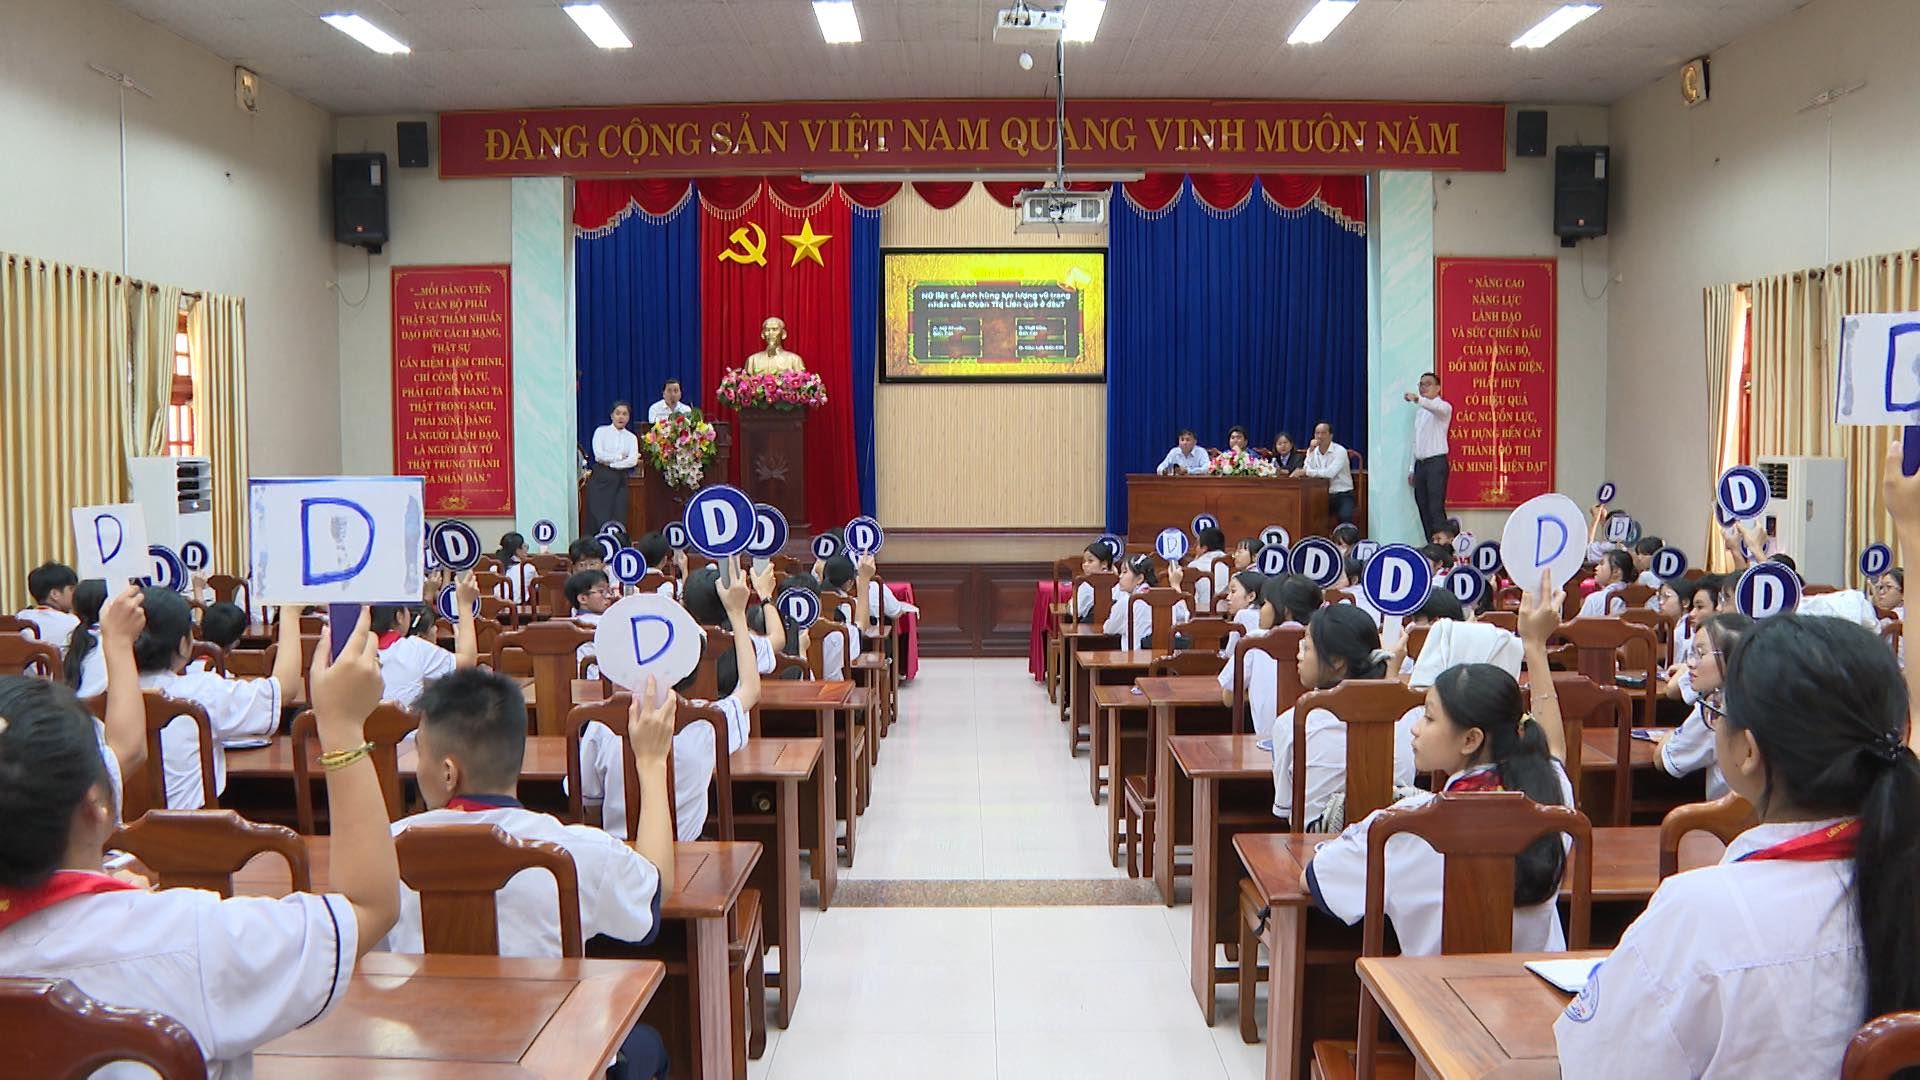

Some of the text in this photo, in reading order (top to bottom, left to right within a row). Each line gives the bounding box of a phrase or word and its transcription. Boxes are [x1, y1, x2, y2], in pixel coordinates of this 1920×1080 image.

[484, 112, 1460, 164] ĐẢNG CỘNG SẢN VIỆT NAM QUANG VINH MUÔN NĂM
[468, 282, 492, 294] VIÊN
[1504, 279, 1525, 288] CAO
[961, 291, 977, 300] Anh
[1502, 295, 1521, 308] LỰC
[414, 297, 487, 311] VÀ CÁN BỘ PHẢI
[401, 314, 425, 327] THẬT
[426, 314, 439, 326] SỰ
[444, 328, 469, 339] CÁCH
[1451, 325, 1465, 338] VÀ
[1466, 325, 1486, 338] SỨC
[1488, 322, 1519, 338] CHIẾN
[432, 342, 471, 355] THẬT SỰ
[1463, 341, 1483, 355] CỦA
[446, 355, 469, 368] LIÊM
[471, 356, 504, 368] CHÍNH,
[1467, 359, 1488, 372] MỚI
[1489, 358, 1517, 372] TOÀN
[414, 371, 430, 382] CHÍ
[432, 371, 458, 382] CÔNG
[460, 371, 473, 381] VÔ
[1472, 376, 1521, 388] PHÁT HUY
[402, 386, 424, 398] PHẢI
[1465, 391, 1529, 407] CÓ HIỆU QUẢ
[408, 400, 433, 412] THẬT
[435, 401, 467, 411] TRONG
[414, 414, 436, 426] PHẢI
[1456, 409, 1476, 422] CÁC
[406, 429, 419, 440] LÀ
[1450, 424, 1542, 441] XÂY DỰNG BẾN CÁT
[414, 444, 426, 455] LÀ
[1462, 443, 1496, 456] THÀNH
[1514, 445, 1531, 457] THỊ
[407, 458, 500, 472] THẬT TRUNG THÀNH
[1467, 461, 1493, 472] MINH
[1500, 459, 1524, 473] HIỆN
[437, 471, 463, 484] NHÂN
[1600, 485, 1613, 501] D
[1728, 475, 1757, 512] D
[701, 499, 738, 547] D
[1614, 521, 1625, 536] D
[94, 514, 123, 564] D
[539, 524, 552, 541] D
[670, 527, 684, 546] D
[747, 514, 775, 551] D
[855, 525, 874, 549] D
[301, 497, 375, 586] D
[442, 530, 469, 562] D
[818, 538, 835, 557] D
[1167, 536, 1178, 554] D
[1459, 537, 1471, 553] D
[1535, 515, 1569, 568] D
[187, 545, 203, 567] D
[1264, 550, 1284, 575] D
[1303, 546, 1331, 581] D
[1479, 547, 1497, 570] D
[1658, 551, 1679, 575] D
[1867, 550, 1885, 572] D
[620, 554, 638, 578] D
[1379, 556, 1414, 602] D
[1453, 572, 1475, 601] D
[1752, 574, 1785, 619] D
[789, 597, 811, 623] D
[630, 615, 675, 666] D
